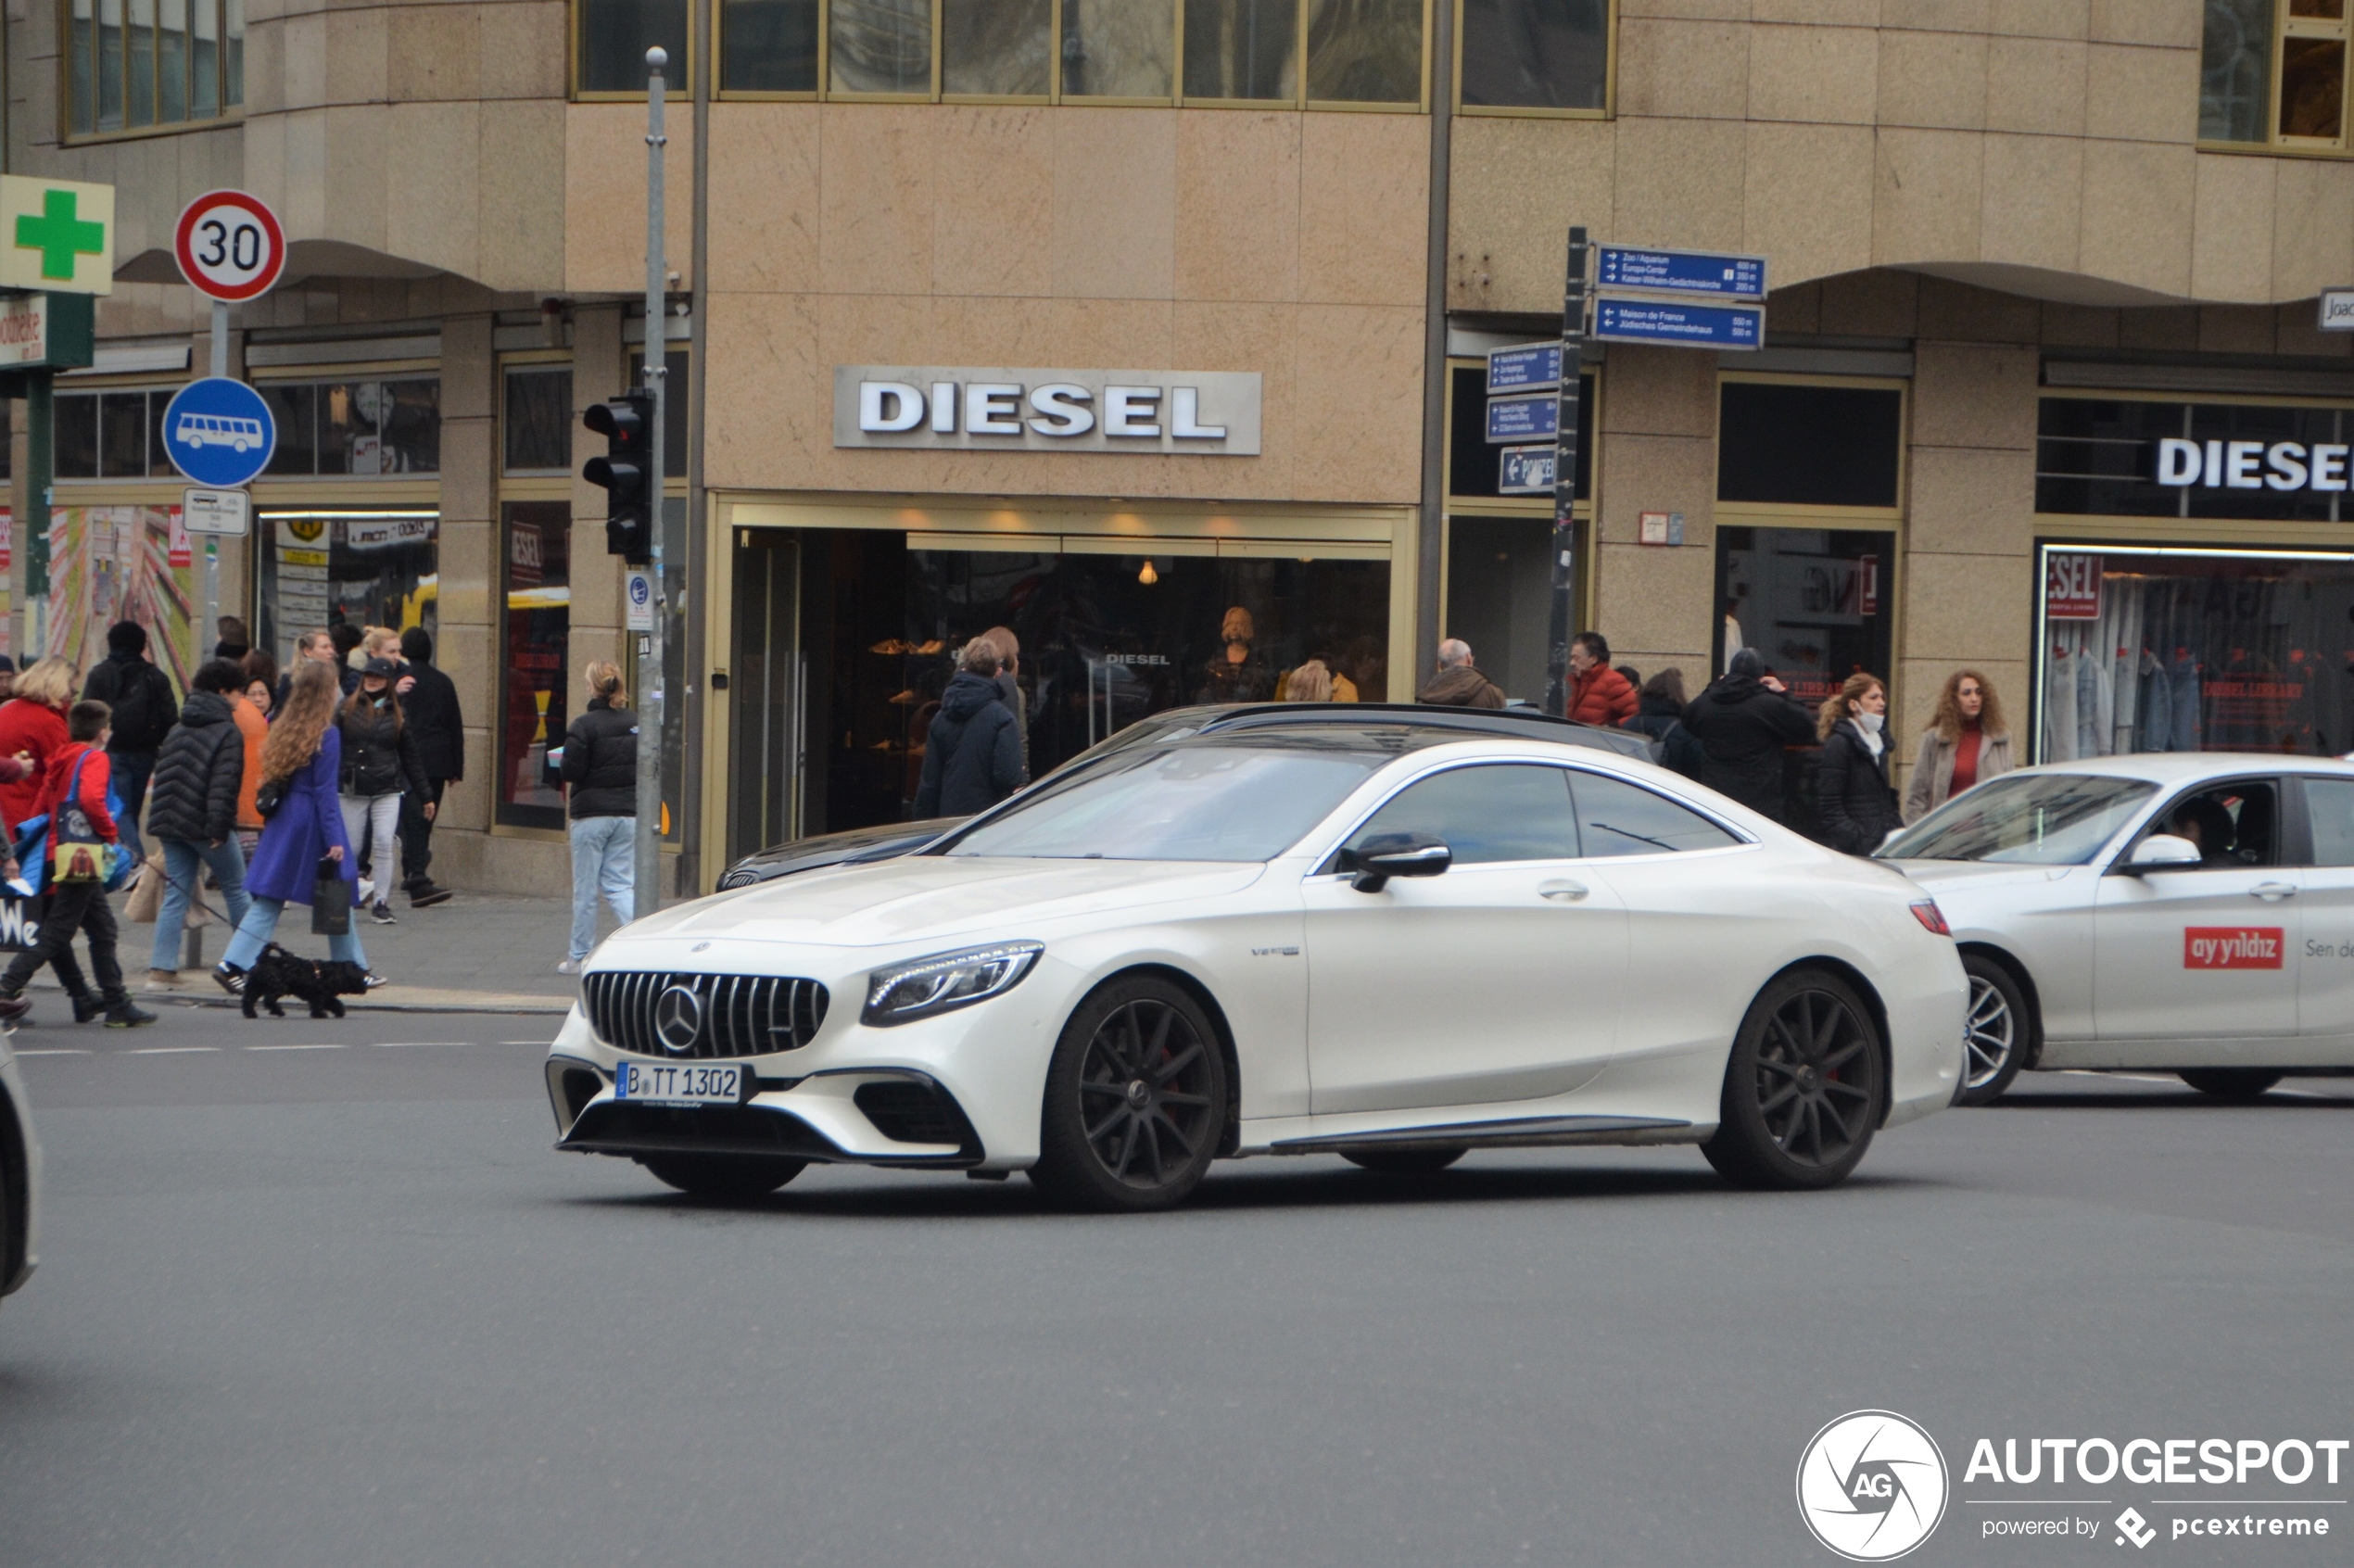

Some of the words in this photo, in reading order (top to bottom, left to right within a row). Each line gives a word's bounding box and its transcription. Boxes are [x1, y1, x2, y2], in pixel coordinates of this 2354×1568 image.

[198, 221, 260, 270] 30
[1639, 254, 1669, 264] Aquarium
[1620, 310, 1647, 319] Maison
[1648, 310, 1658, 319] de
[1659, 311, 1686, 322] France
[1657, 322, 1713, 335] Gemeindehaus
[859, 380, 1229, 438] DIESEL
[2157, 437, 2354, 491] DIESE
[1107, 652, 1171, 665] DIESEL
[2192, 938, 2219, 965] ay
[2306, 939, 2335, 957] Sen
[628, 1067, 639, 1094] B
[652, 1067, 677, 1095] TT
[681, 1068, 737, 1097] 1302
